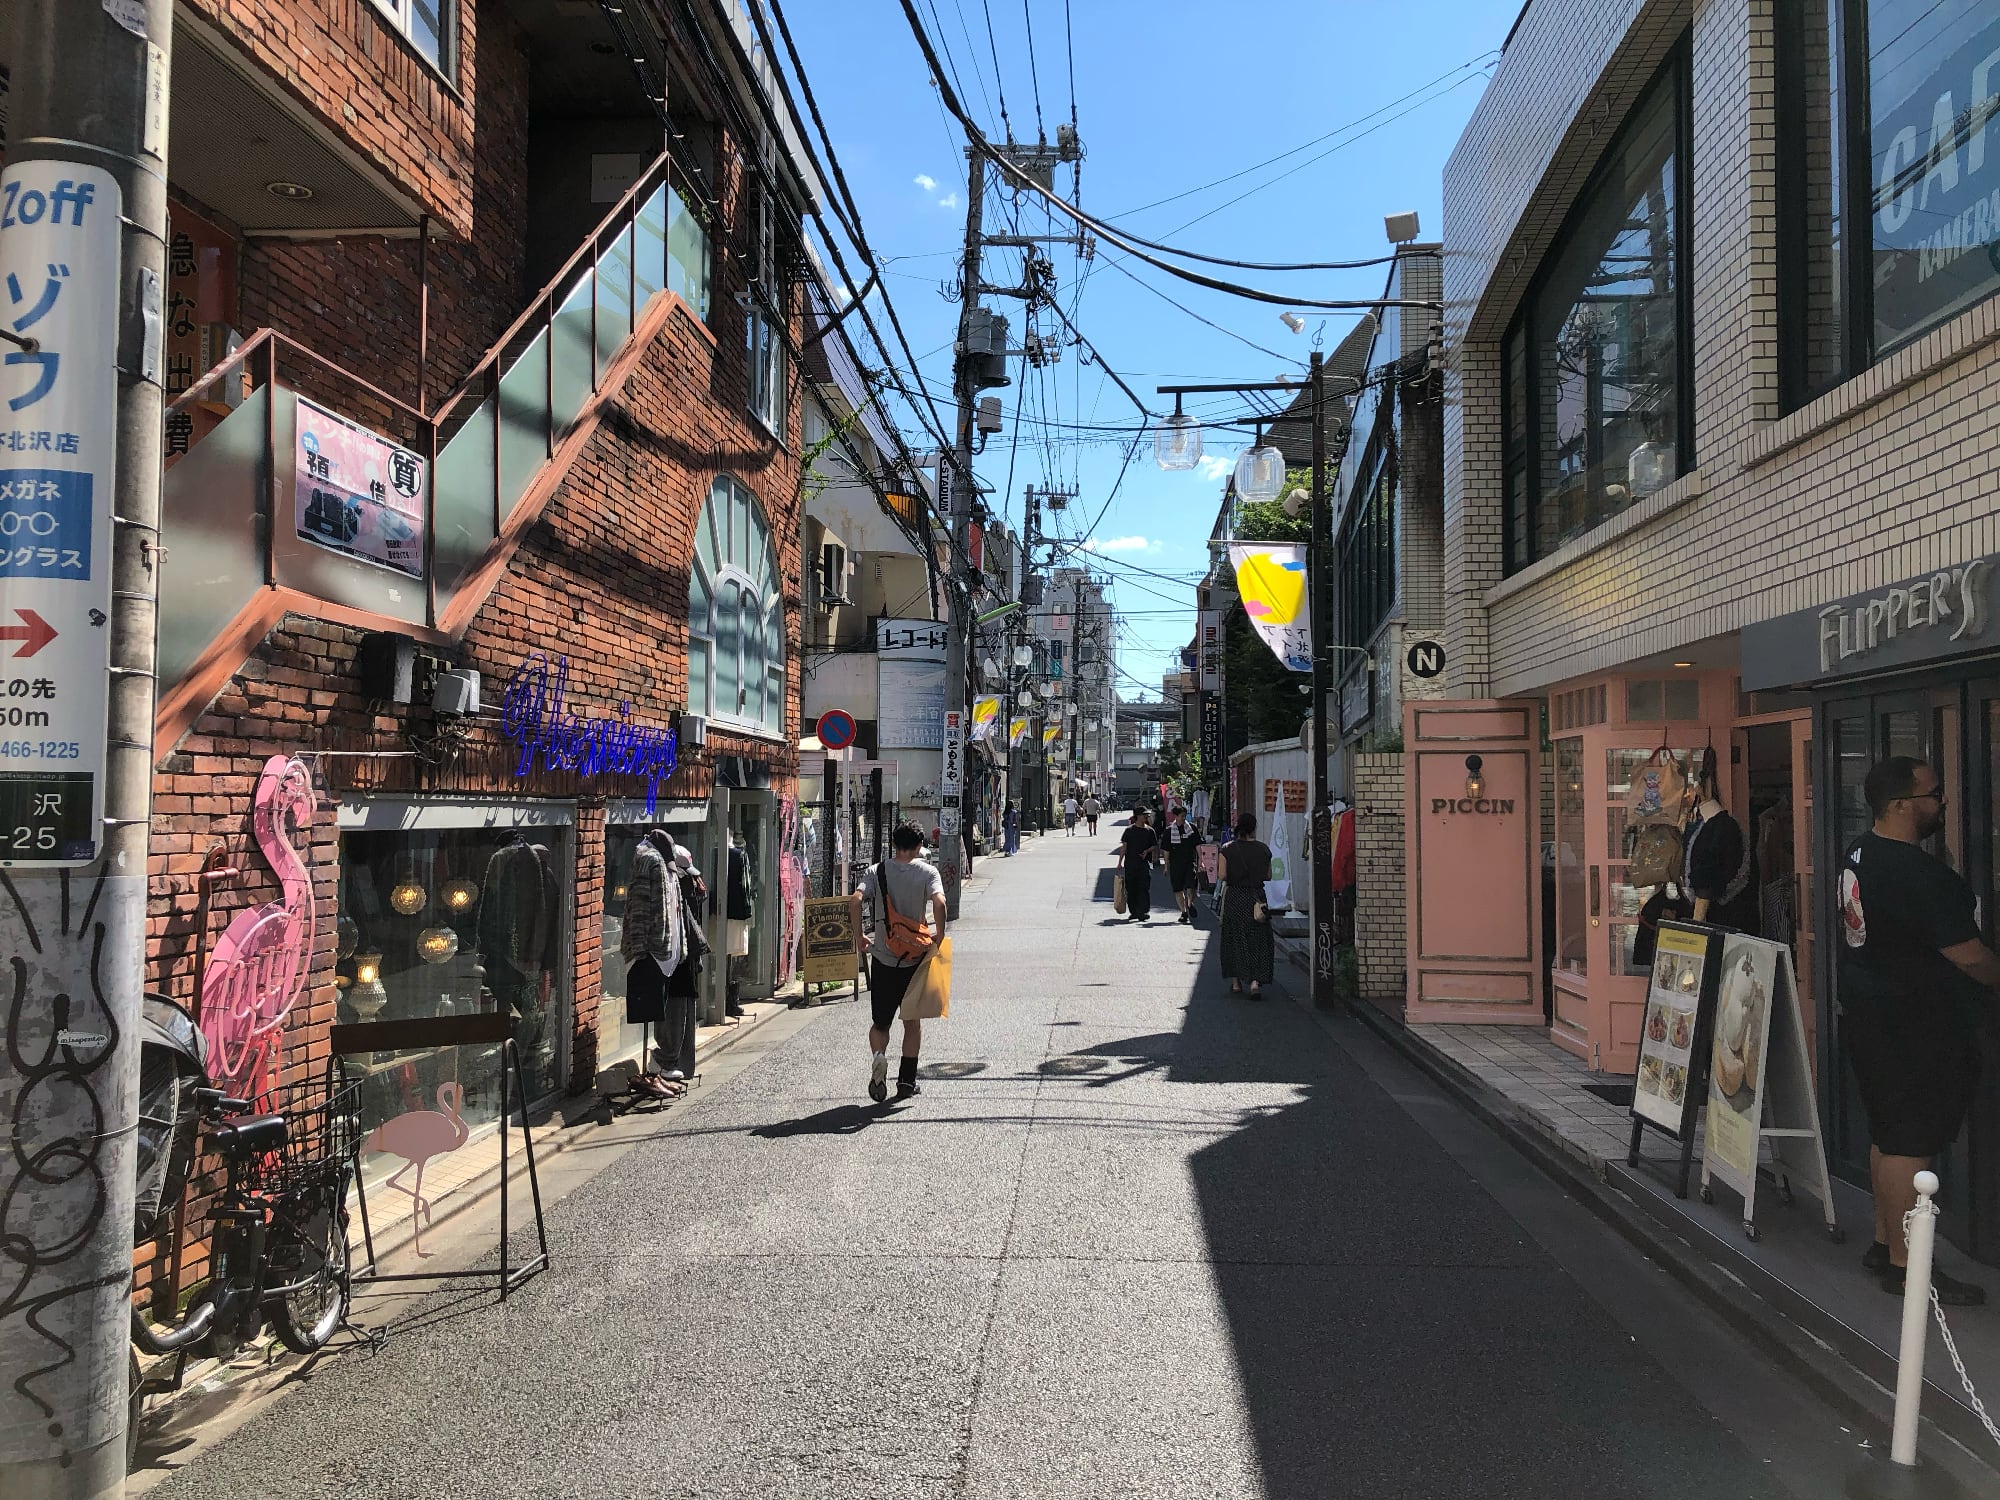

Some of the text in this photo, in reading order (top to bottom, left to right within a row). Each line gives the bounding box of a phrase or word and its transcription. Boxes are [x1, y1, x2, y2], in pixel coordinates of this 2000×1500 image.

[1, 180, 95, 229] Zoff
[5, 263, 71, 413] ゾフ
[0, 479, 62, 501] メガネ
[1819, 559, 1984, 673] FLIPPER'S
[1416, 648, 1437, 671] N
[1, 741, 80, 759] 466-1225
[946, 740, 958, 781] ともえや
[33, 793, 62, 816] 沢
[1431, 798, 1514, 814] PICCIN
